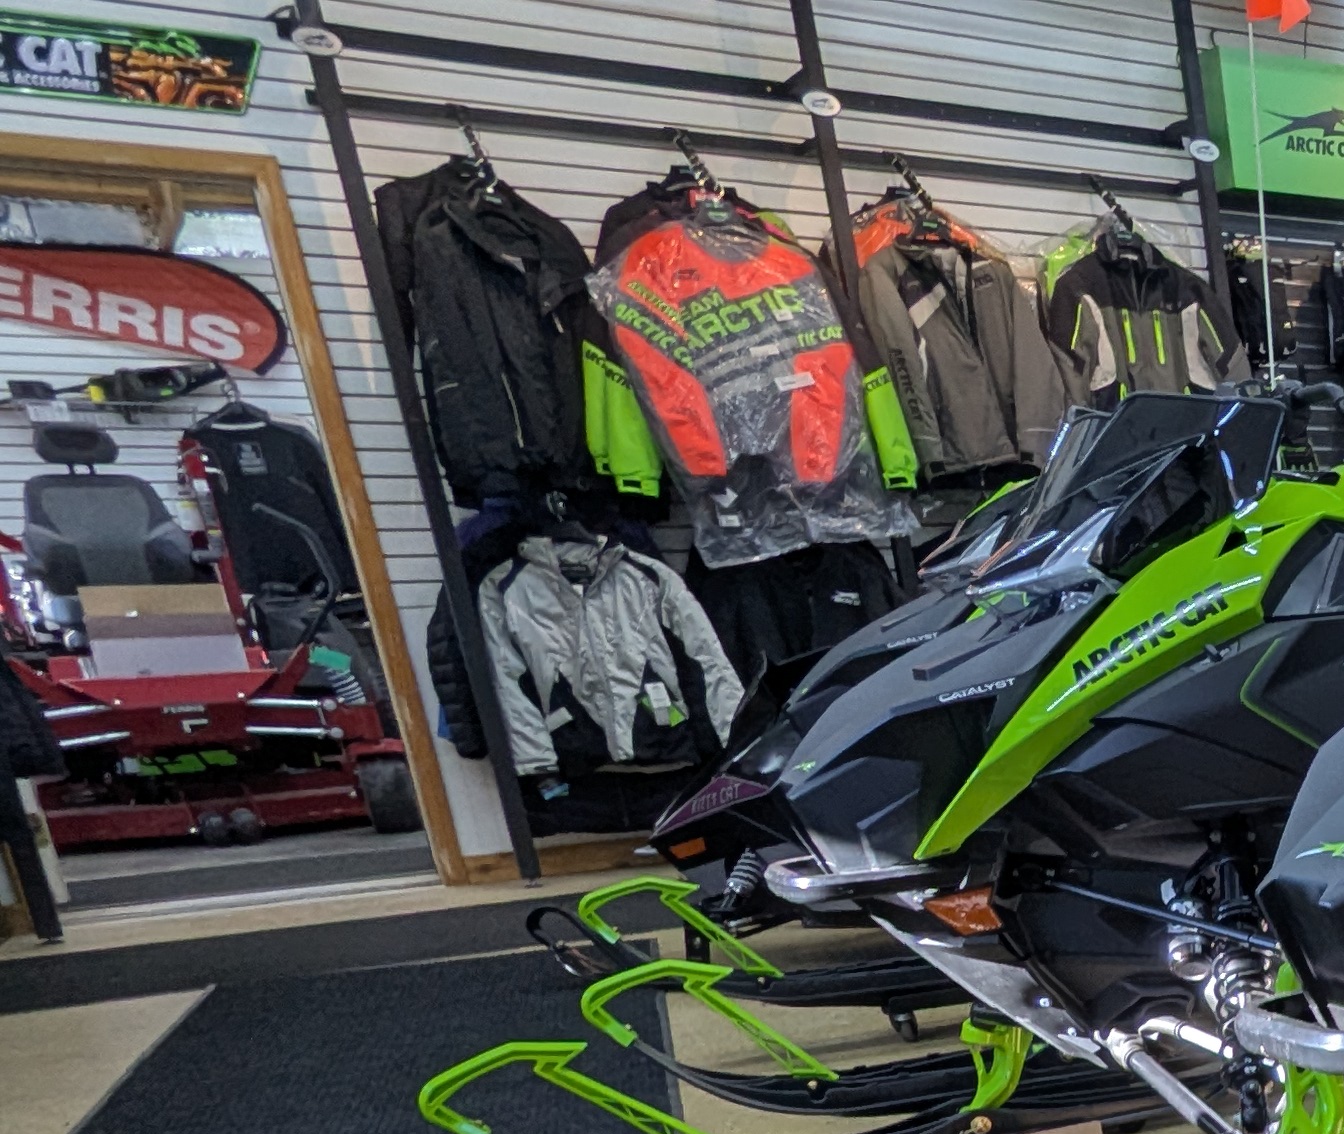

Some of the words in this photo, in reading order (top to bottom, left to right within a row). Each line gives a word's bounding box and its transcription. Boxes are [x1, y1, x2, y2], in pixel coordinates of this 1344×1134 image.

[16, 35, 102, 77] CAT
[1285, 135, 1335, 157] ARCTIC
[1073, 611, 1176, 692] ARCTIC
[1175, 582, 1229, 628] CAT
[938, 677, 1016, 703] CATALYST
